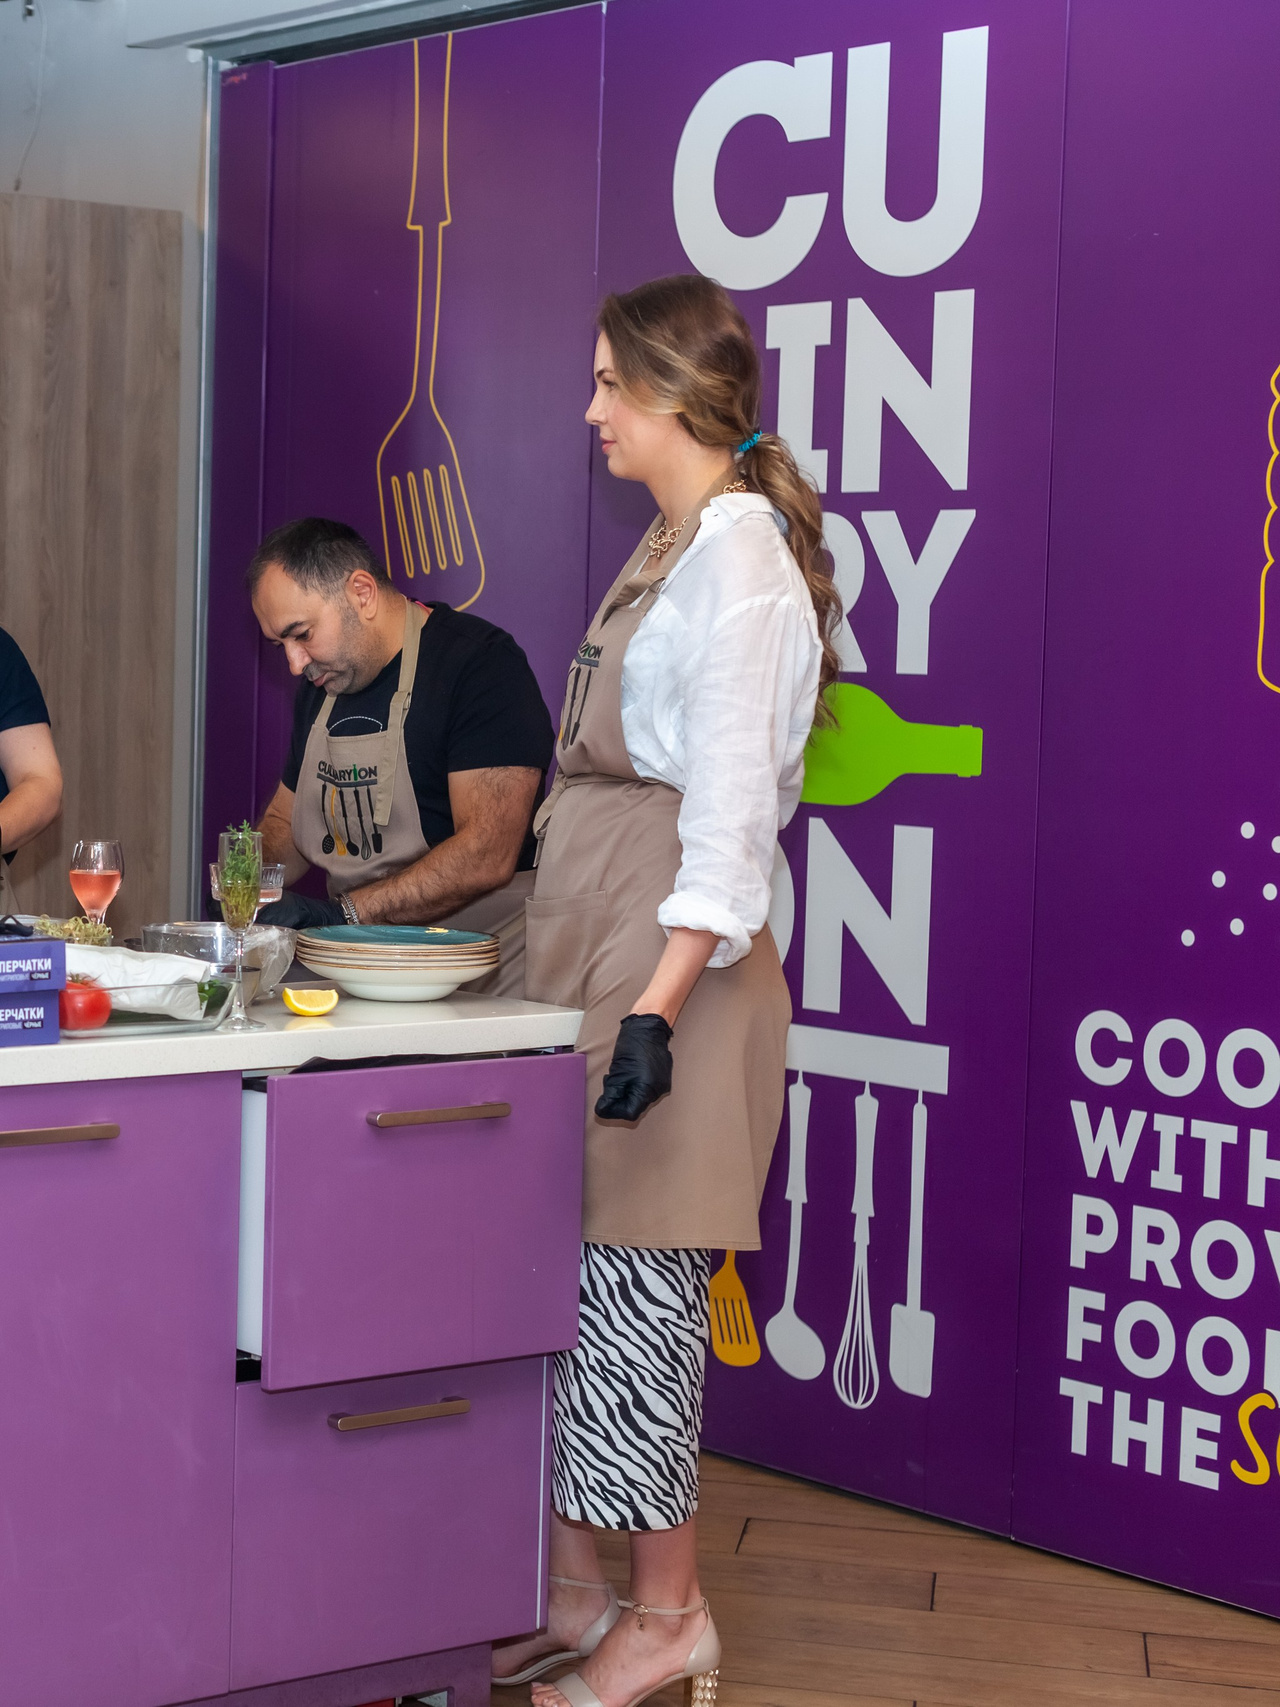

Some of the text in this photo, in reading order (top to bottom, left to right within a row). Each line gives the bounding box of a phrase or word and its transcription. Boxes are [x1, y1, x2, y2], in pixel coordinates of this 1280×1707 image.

[673, 25, 989, 291] CU
[765, 288, 975, 494] IN
[820, 508, 977, 675] RY
[1069, 1193, 1280, 1300] PRO
[1058, 1376, 1222, 1491] THE
